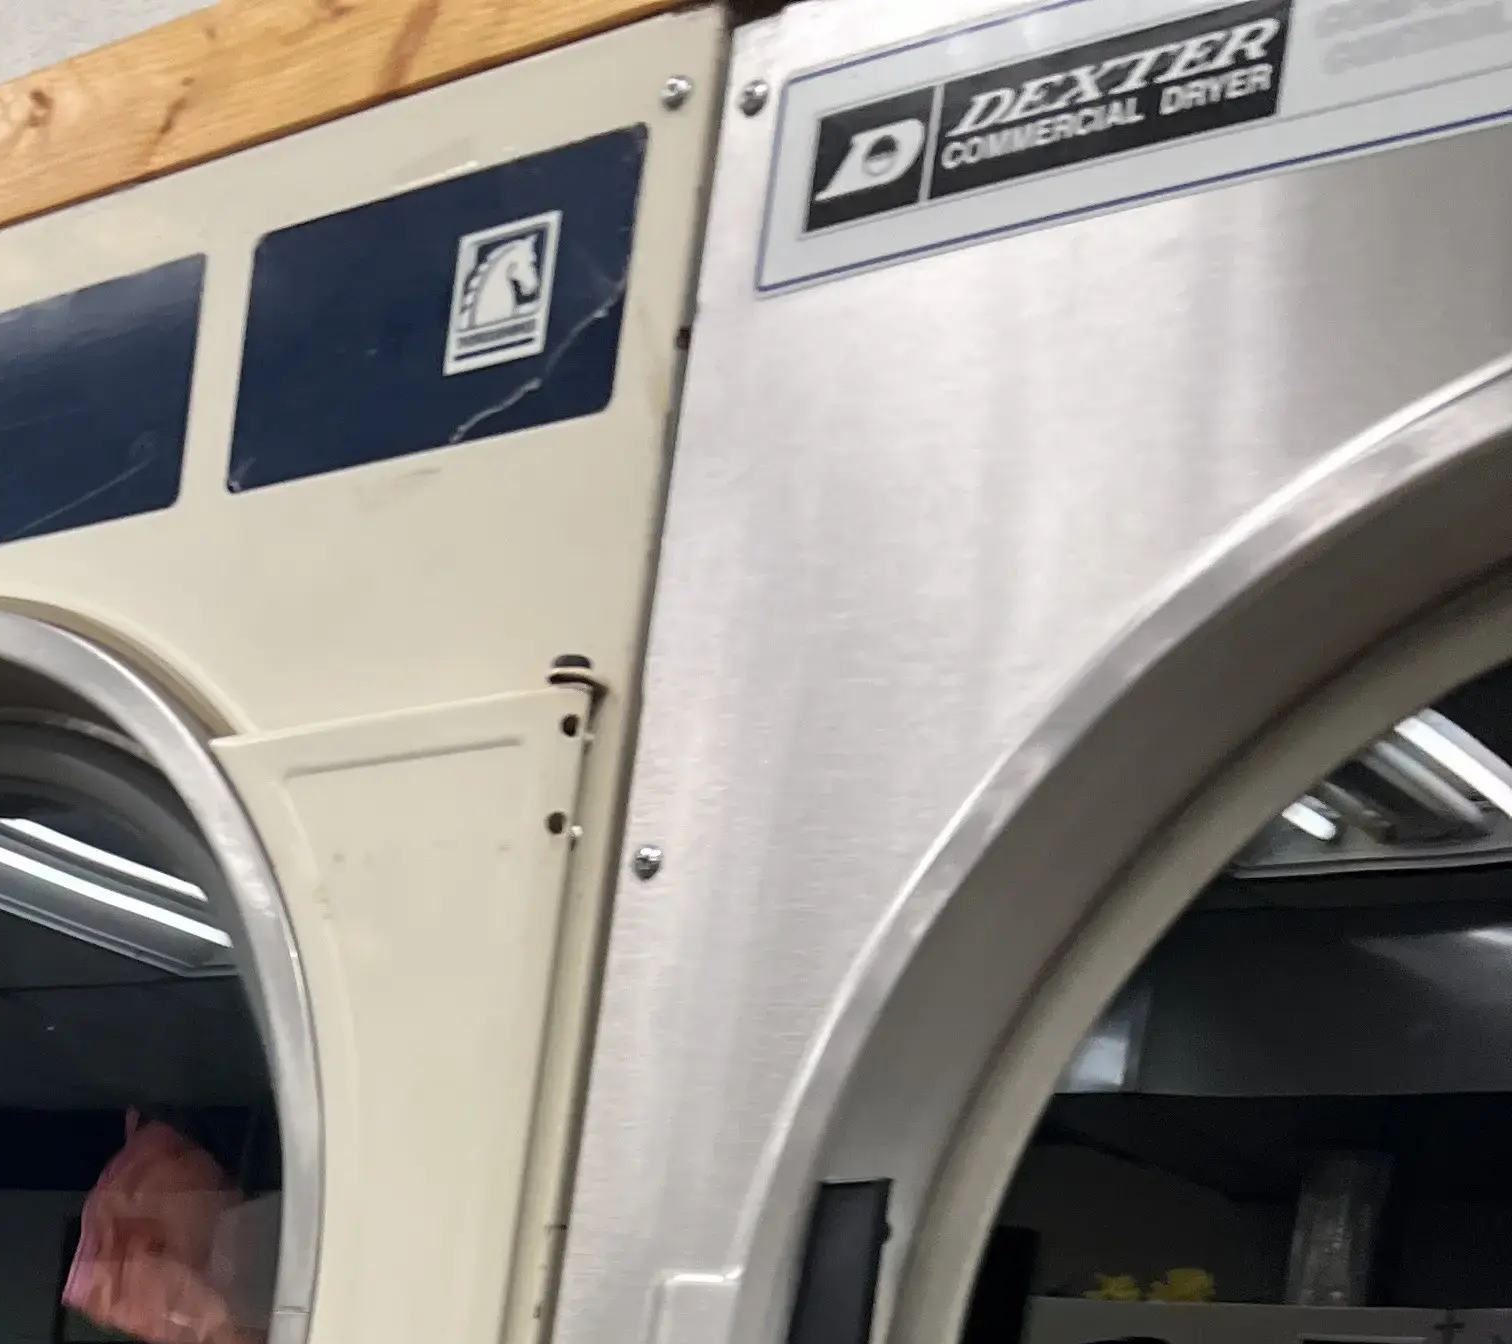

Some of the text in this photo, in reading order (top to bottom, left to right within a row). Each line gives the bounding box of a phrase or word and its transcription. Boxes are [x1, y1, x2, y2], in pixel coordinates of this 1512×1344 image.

[940, 97, 1147, 171] COMMERCIAL
[1157, 63, 1273, 118] DRYER
[944, 16, 1282, 137] DEXTER
